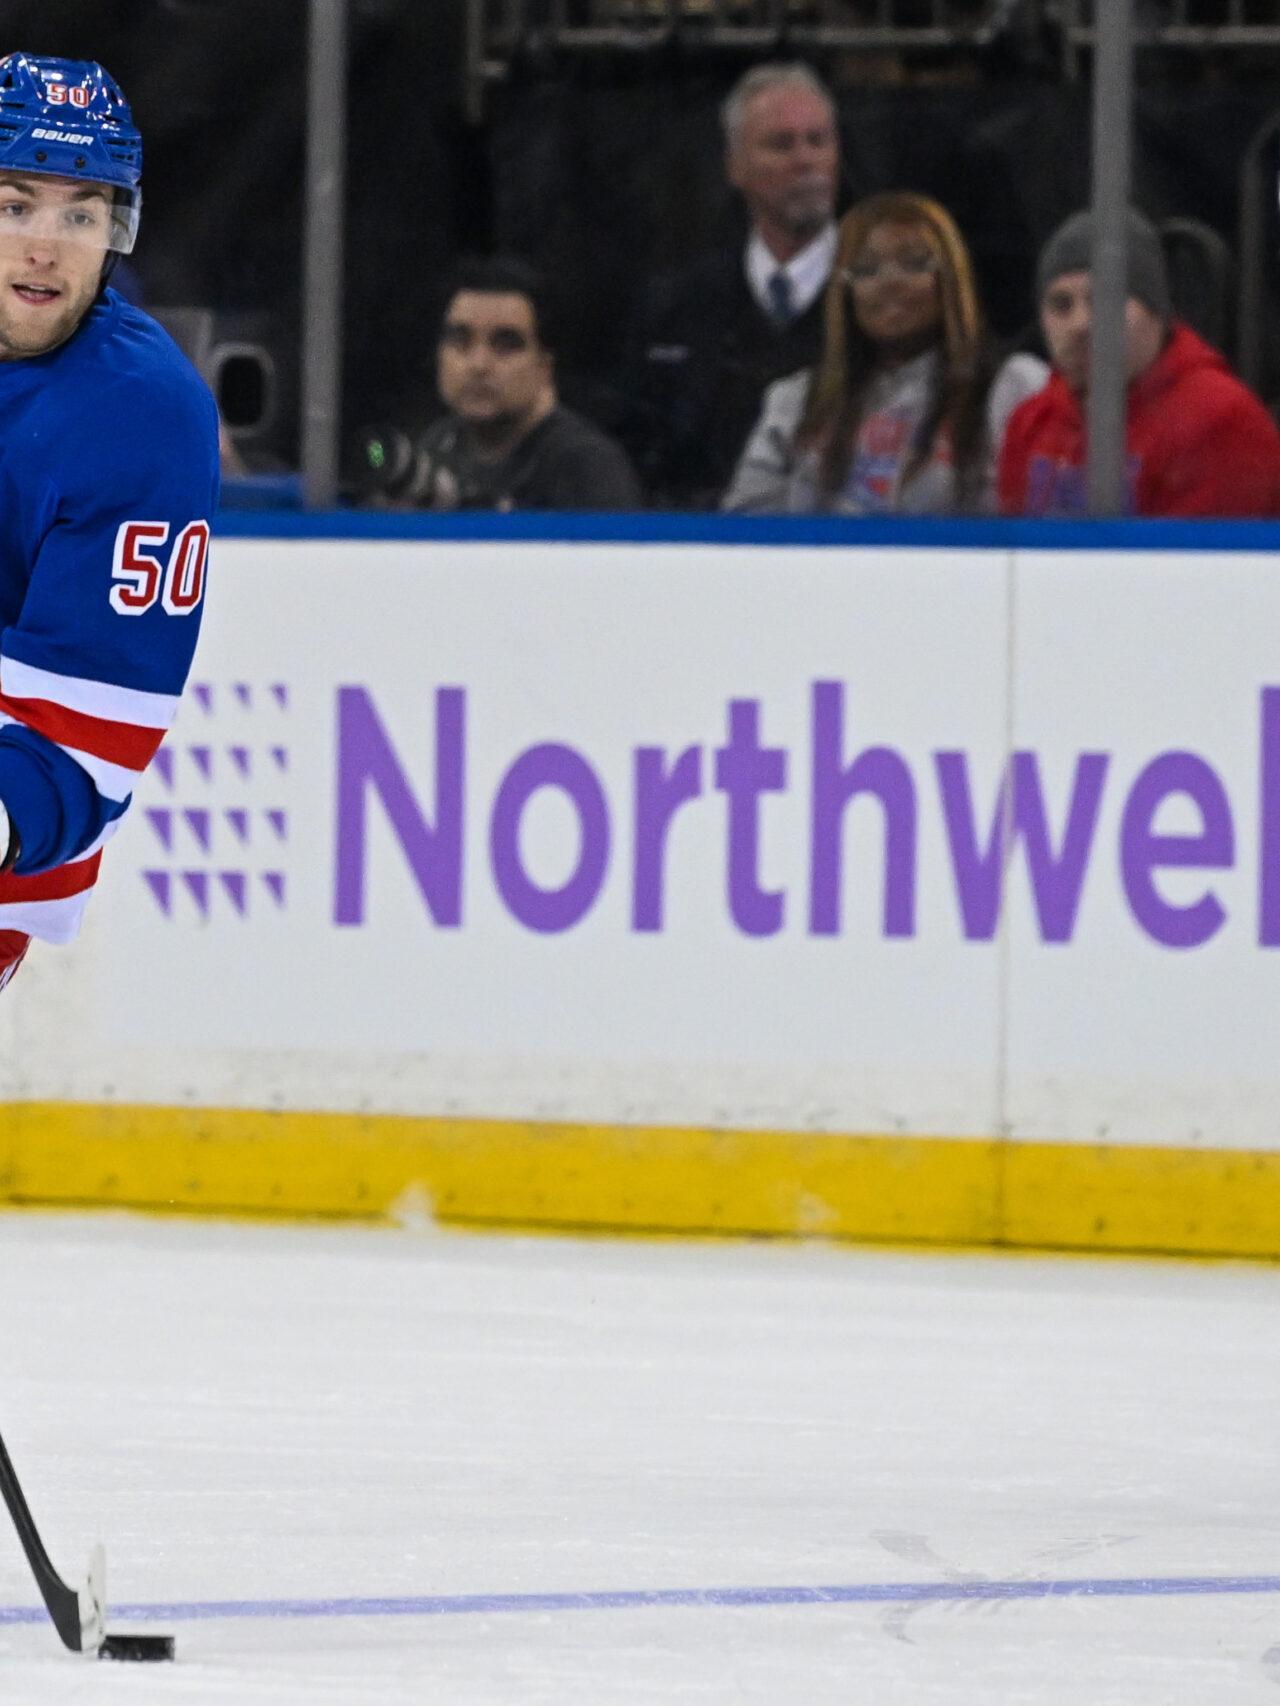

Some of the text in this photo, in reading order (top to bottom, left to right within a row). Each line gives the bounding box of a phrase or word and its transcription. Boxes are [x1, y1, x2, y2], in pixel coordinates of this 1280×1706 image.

[46, 83, 90, 108] 50
[31, 128, 94, 146] BAUER
[109, 519, 211, 616] 50
